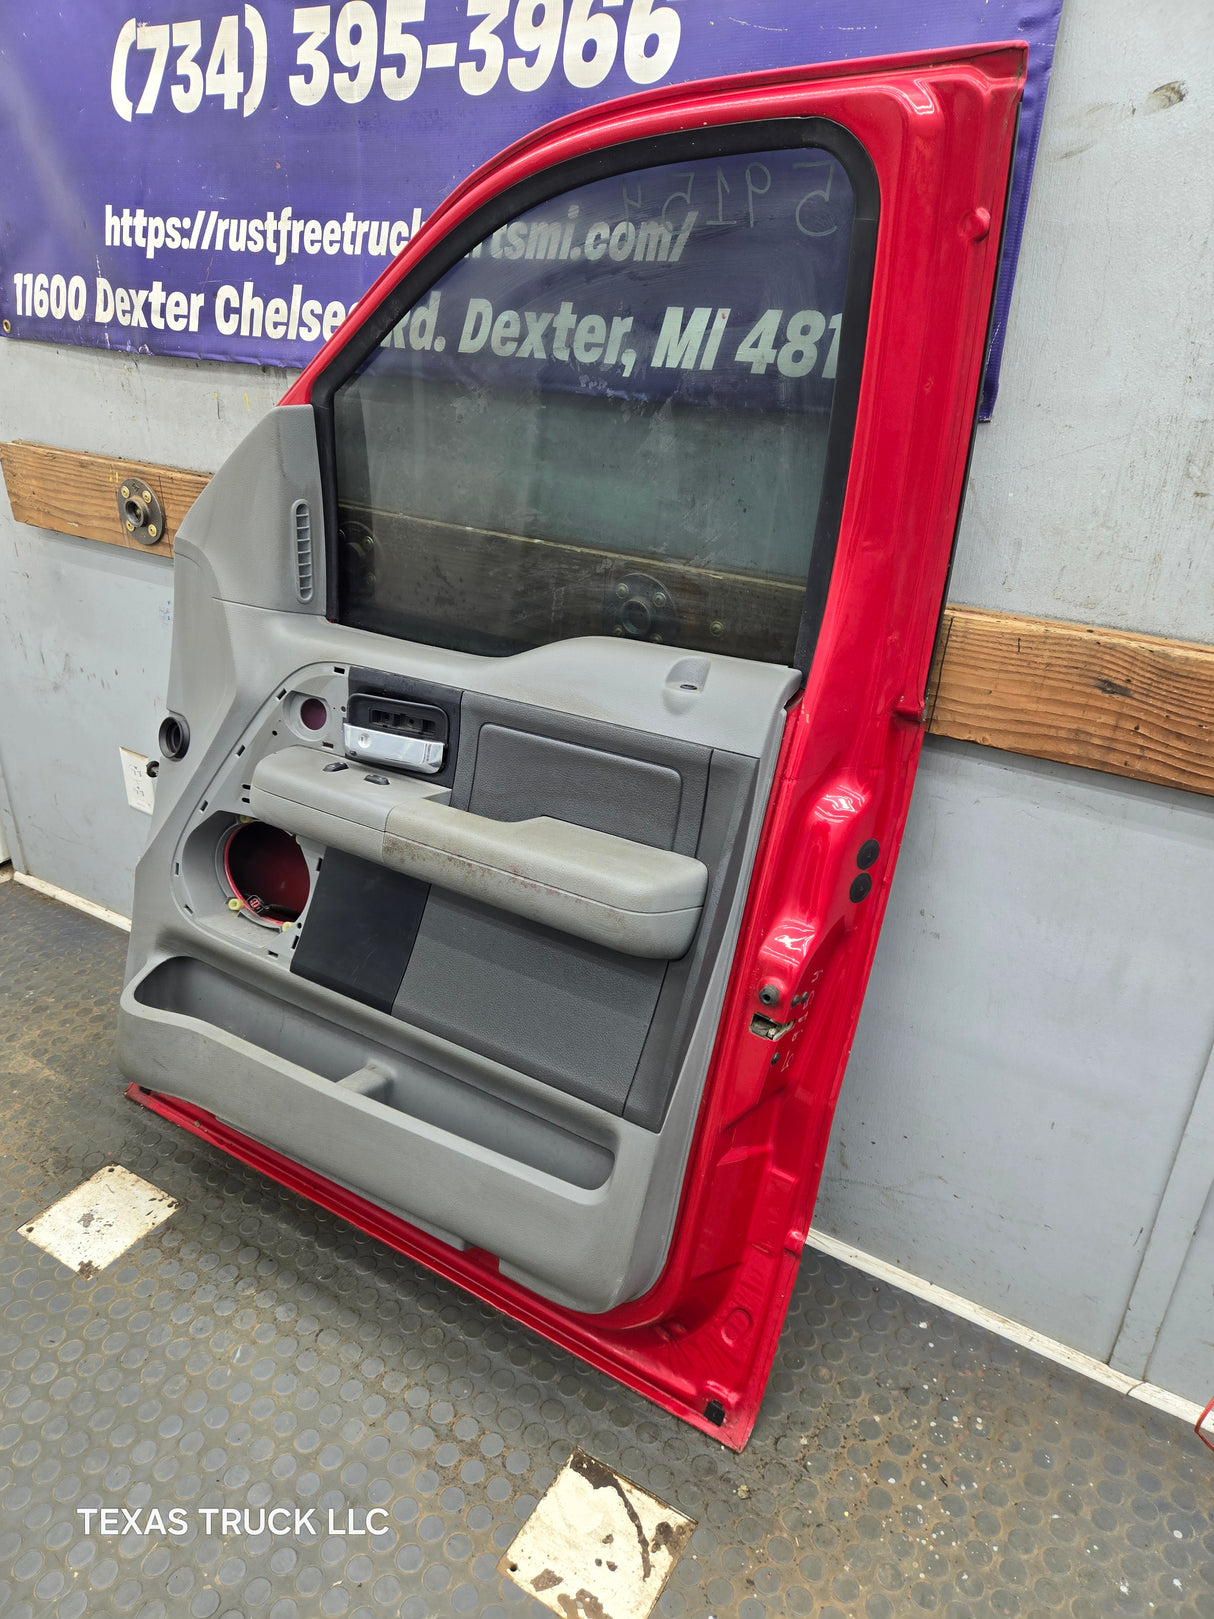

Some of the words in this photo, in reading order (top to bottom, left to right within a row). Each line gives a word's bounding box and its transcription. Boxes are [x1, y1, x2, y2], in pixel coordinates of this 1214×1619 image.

[110, 3, 268, 122] (734)
[288, 0, 682, 105] 395-3966
[13, 272, 87, 321] 11600
[95, 276, 205, 332] Dexter
[214, 282, 361, 341] Chelse
[457, 298, 636, 377] Dexter,
[650, 305, 731, 371] MI
